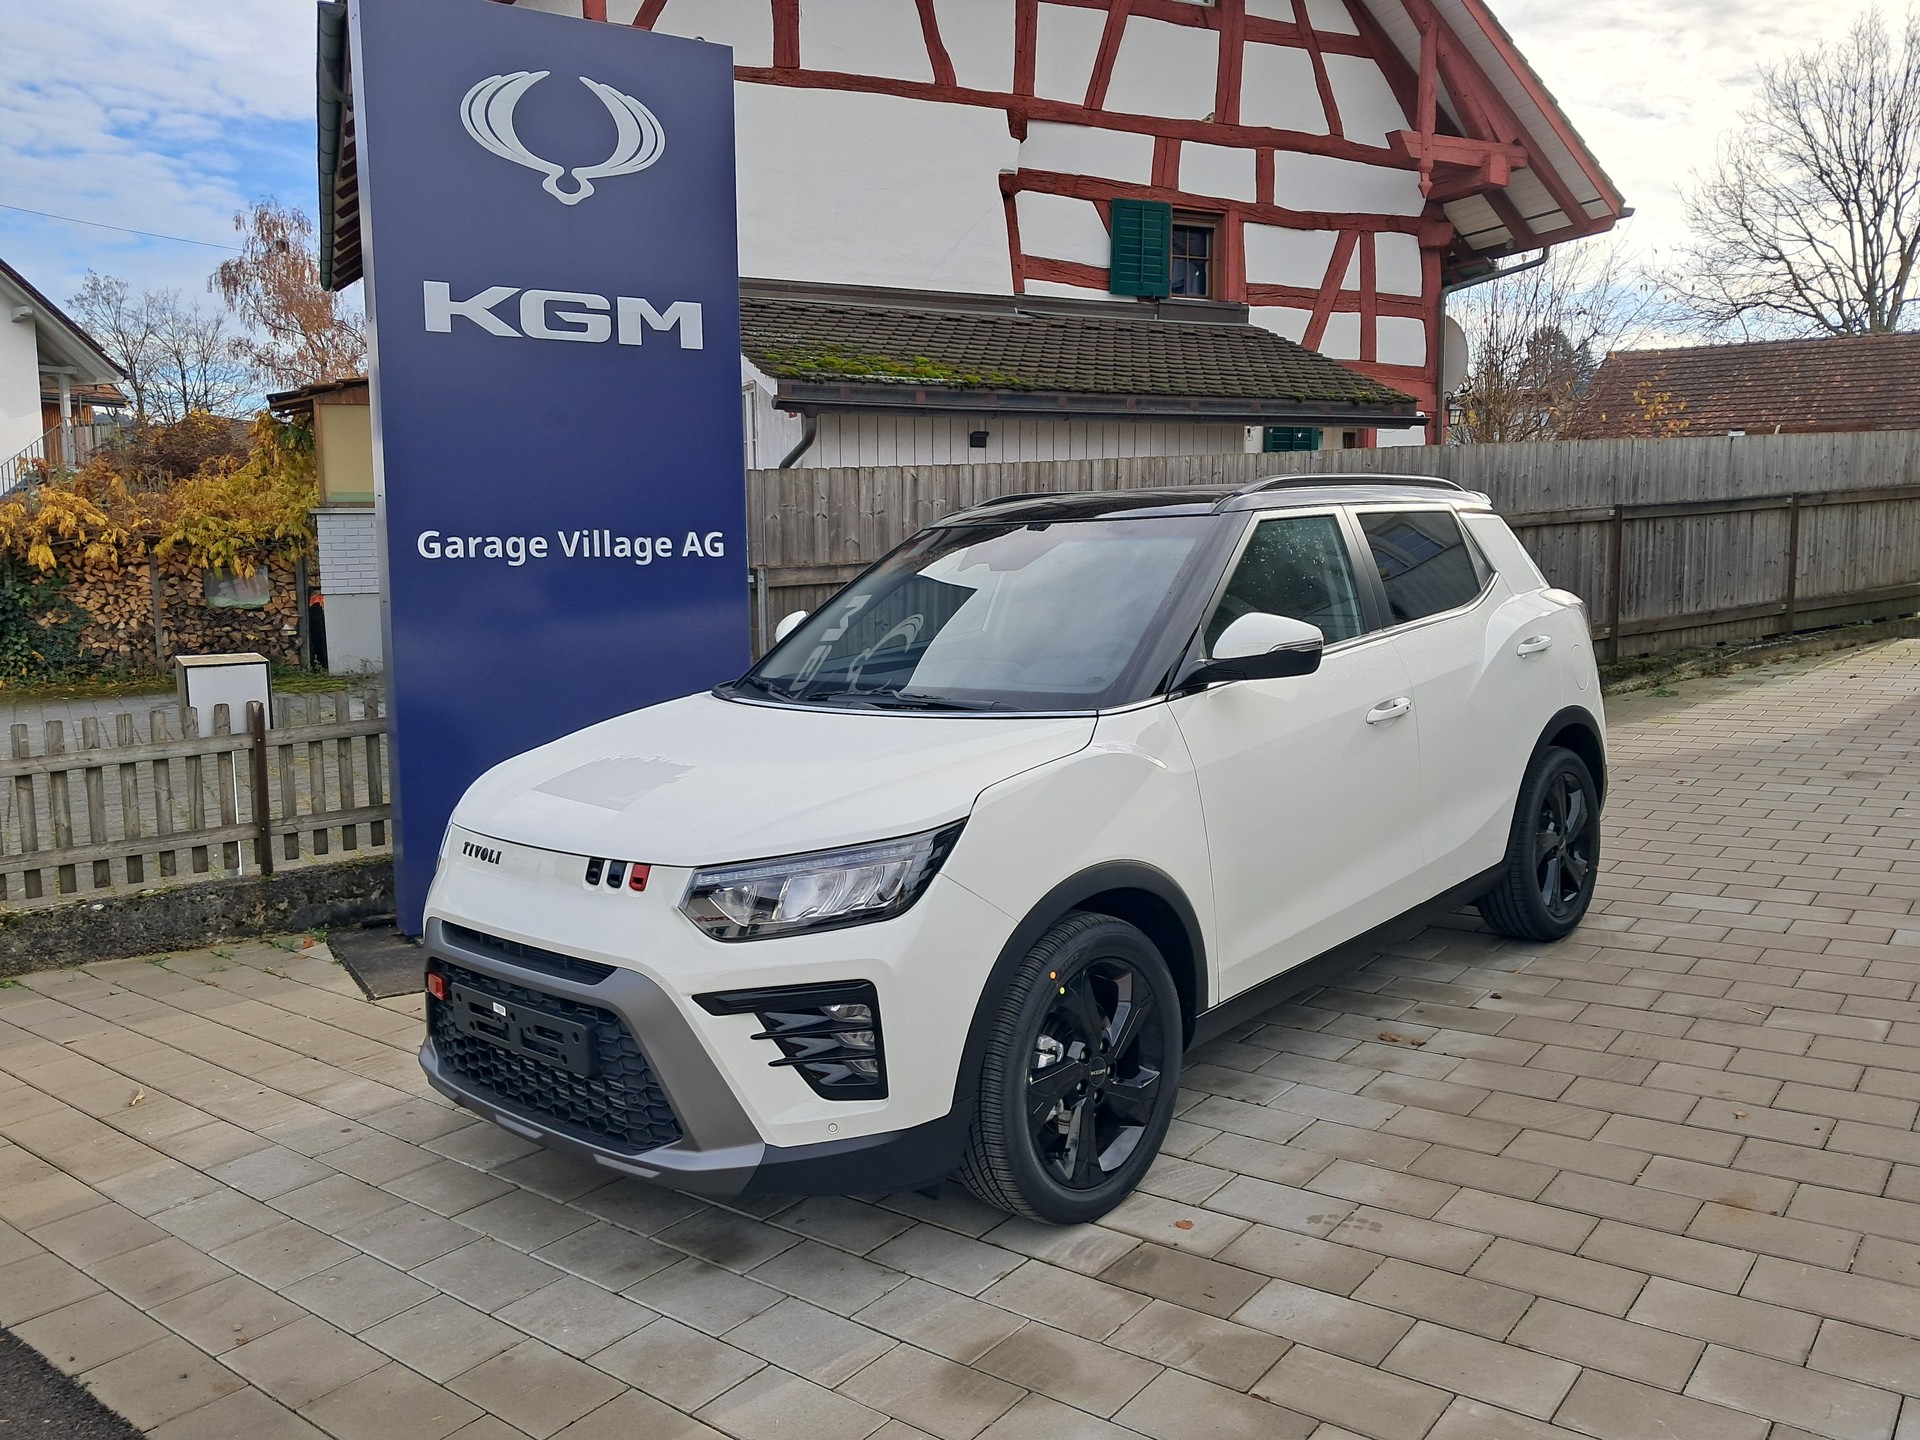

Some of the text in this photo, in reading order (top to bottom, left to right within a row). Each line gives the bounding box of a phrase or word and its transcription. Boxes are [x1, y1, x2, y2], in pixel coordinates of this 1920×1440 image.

[422, 280, 704, 350] KGM
[416, 529, 725, 567] Garage Village AG
[462, 841, 502, 865] TIVOLI
